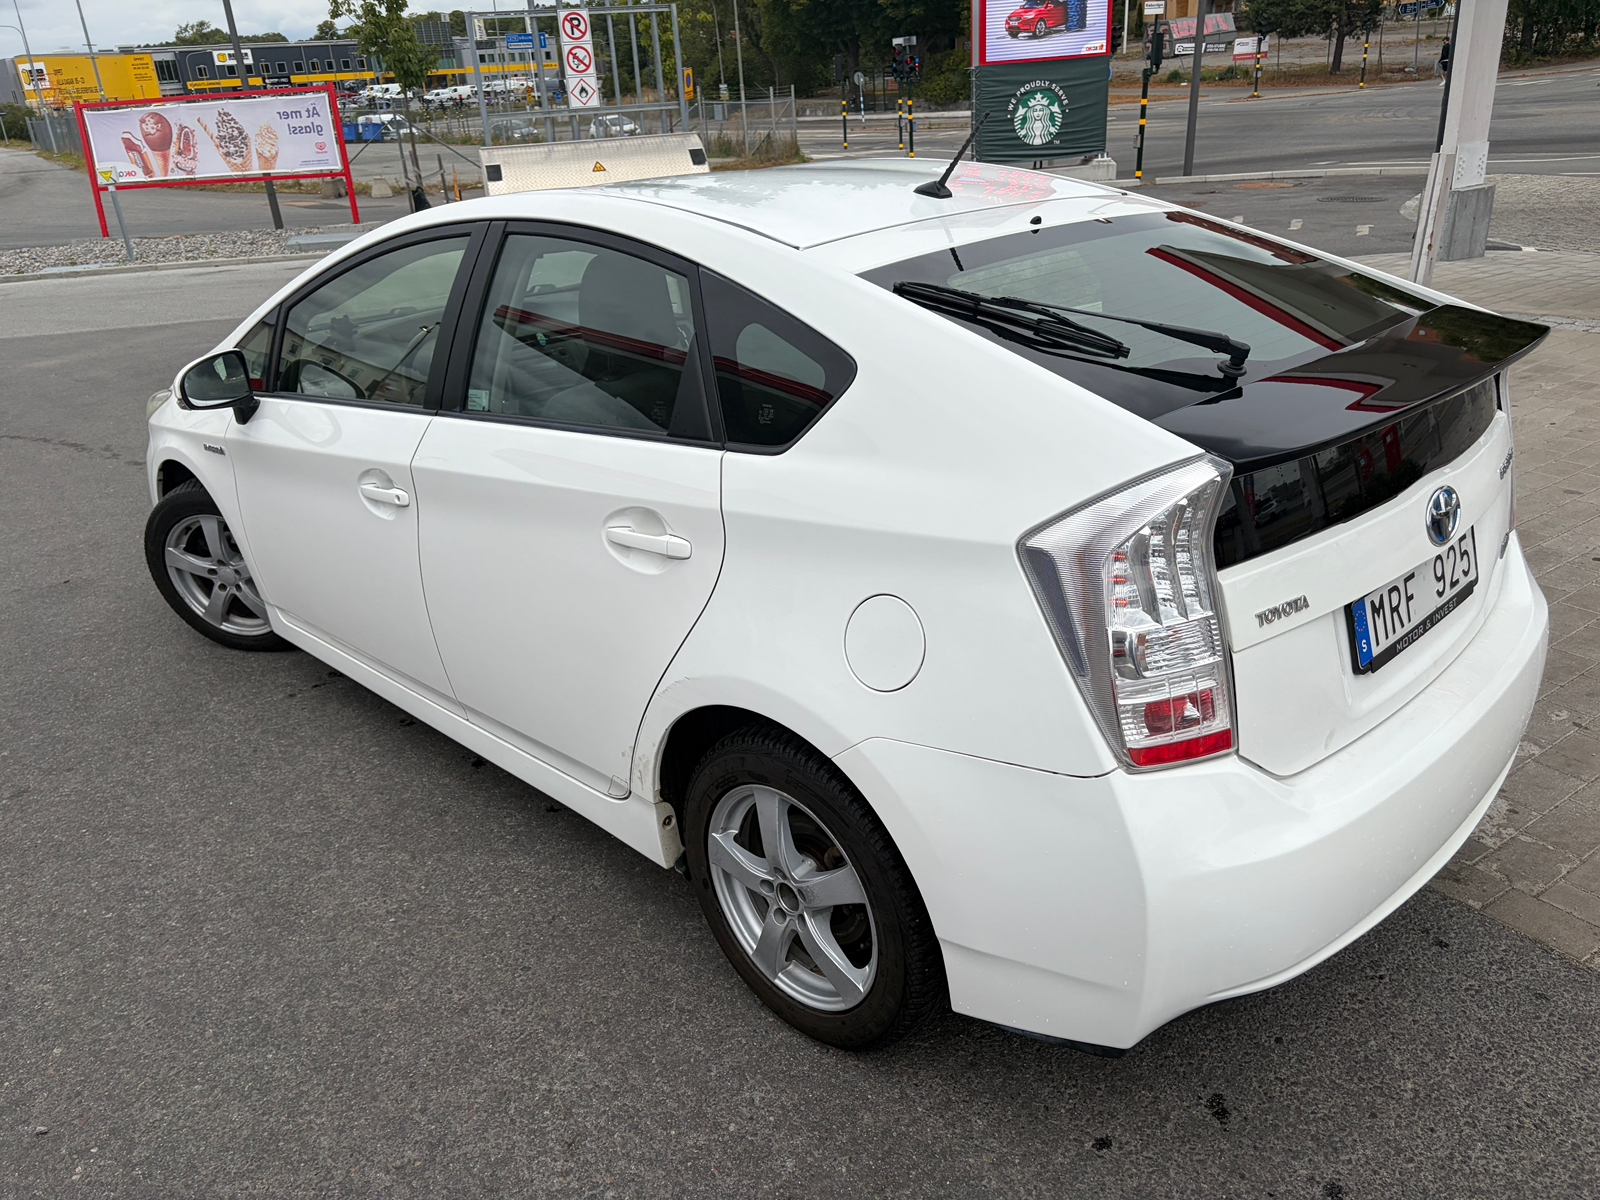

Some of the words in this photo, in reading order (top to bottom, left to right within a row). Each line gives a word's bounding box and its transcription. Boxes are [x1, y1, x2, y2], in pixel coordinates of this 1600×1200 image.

[1007, 97, 1017, 111] WE
[1015, 80, 1050, 97] PROUDLY
[1051, 83, 1069, 105] SERVE
[1369, 571, 1416, 647] MRF
[1432, 532, 1472, 599] 925
[1254, 594, 1311, 629] TOYOTA
[1395, 622, 1424, 653] MOTOR
[1425, 618, 1432, 629] &
[1432, 597, 1459, 625] INVEST
[1361, 639, 1368, 653] S
